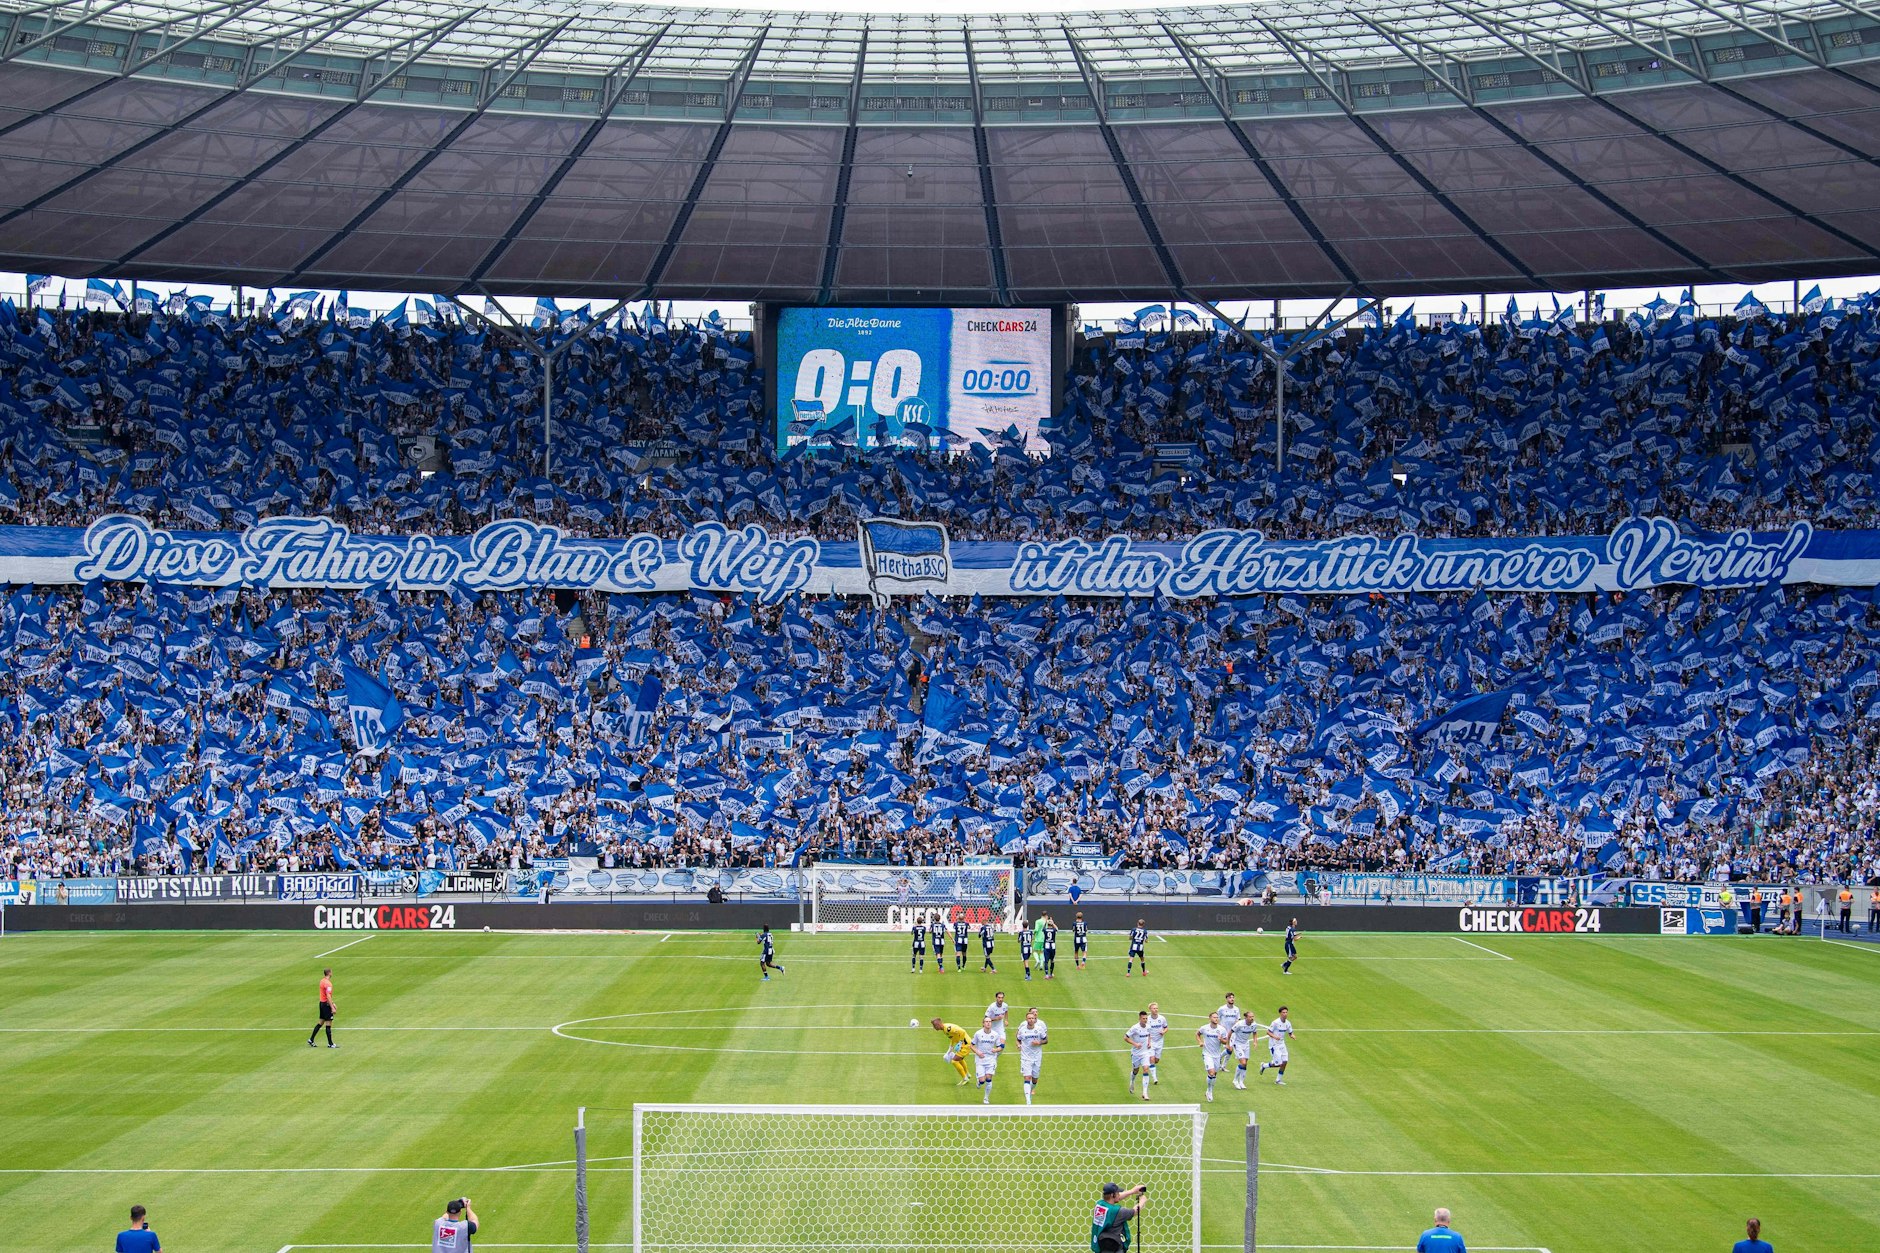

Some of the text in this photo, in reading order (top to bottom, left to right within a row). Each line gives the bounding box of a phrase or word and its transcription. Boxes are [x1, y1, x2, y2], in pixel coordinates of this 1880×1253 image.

[828, 318, 901, 328] Die Alte Dame
[967, 320, 1037, 332] CHECKCARS24
[794, 348, 922, 416] 0:0
[963, 369, 1031, 390] 00:00
[903, 404, 924, 422] KSC
[80, 521, 1810, 600] Diese Fahne in Blau & Weiß ist das Herzstück unseres Vereins!
[117, 876, 223, 899] HAUPTSTADT
[231, 876, 276, 896] KULT
[283, 876, 354, 892] RAGAZZI
[314, 905, 455, 929] CHECKCARS24
[1459, 908, 1600, 932] CHECKCARS24
[957, 926, 966, 934] 37
[1047, 932, 1053, 940] 9
[1076, 925, 1085, 934] 31
[1135, 929, 1144, 939] 22
